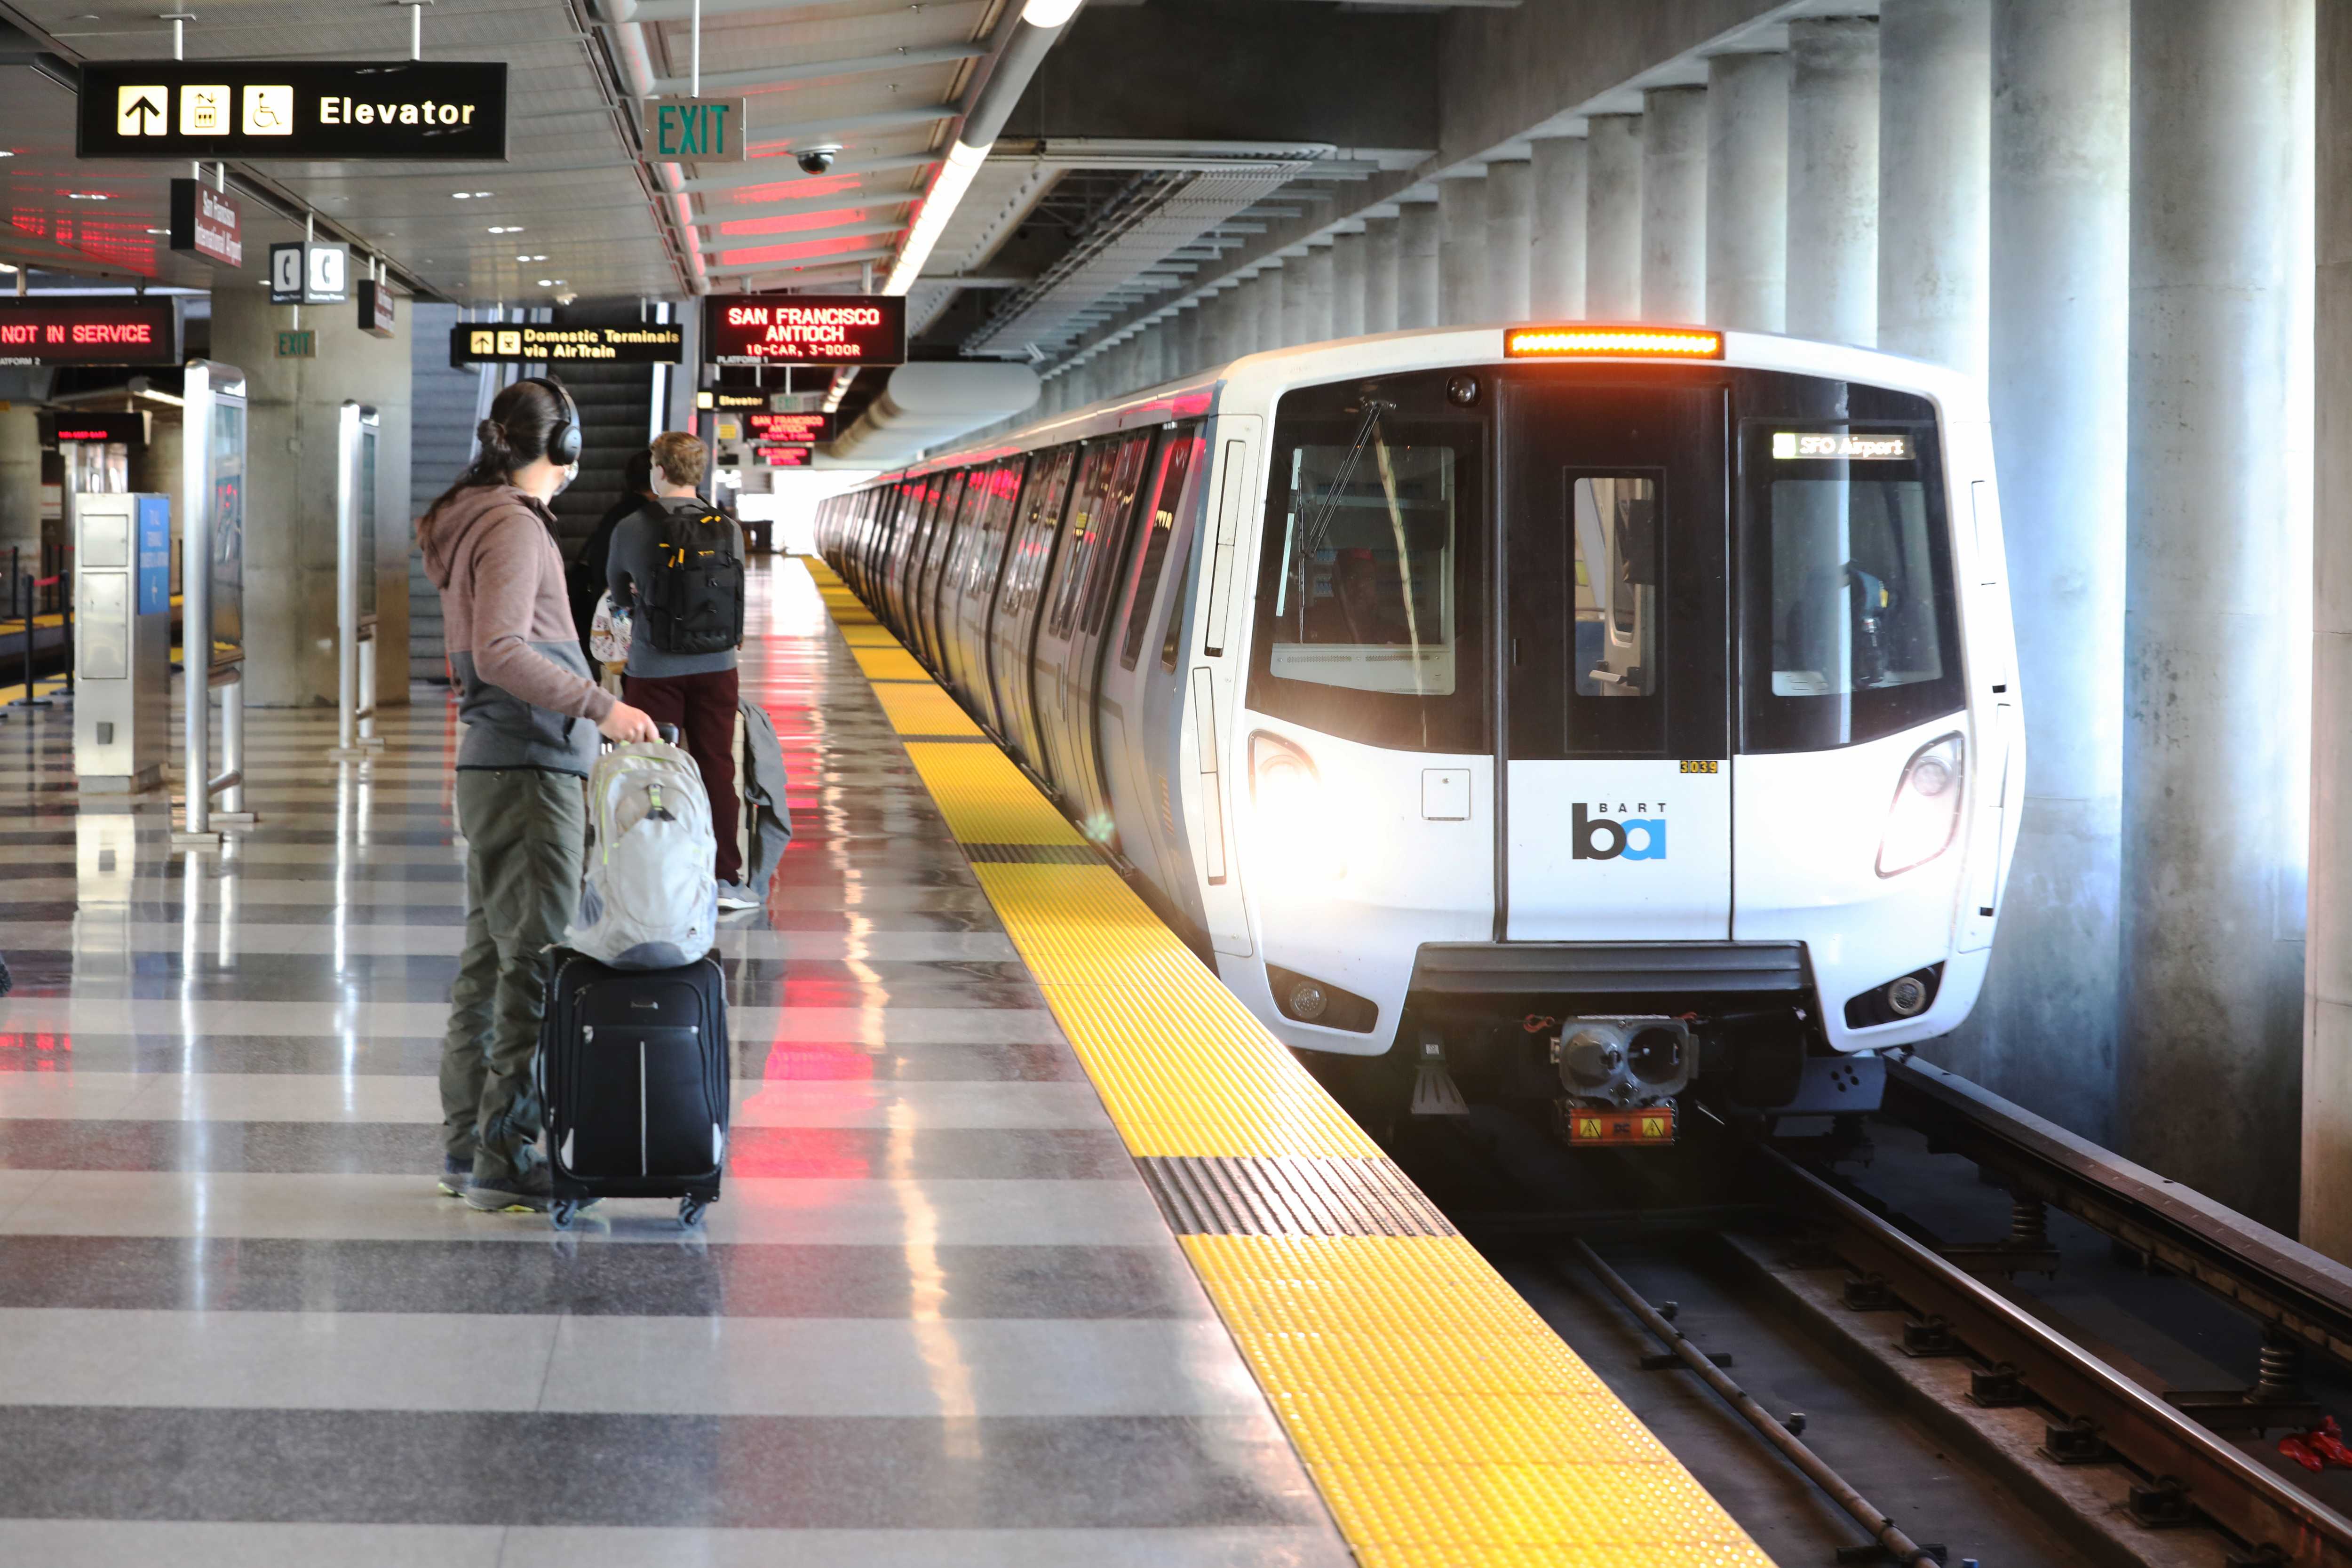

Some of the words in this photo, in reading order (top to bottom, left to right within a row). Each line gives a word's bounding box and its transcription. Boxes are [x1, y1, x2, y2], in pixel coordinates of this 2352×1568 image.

[320, 96, 475, 125] Elevator
[659, 105, 730, 154] EXIT
[728, 308, 768, 325] SAN
[776, 308, 880, 325] FRANCISCO
[1, 325, 39, 343] NOT
[47, 325, 65, 343] IN
[72, 325, 151, 343] SERVICE
[524, 329, 598, 343] Domestic
[605, 330, 680, 343] Terminals
[765, 325, 844, 342] ANTIOCH
[278, 333, 309, 356] EXIT
[524, 346, 548, 358] via
[553, 345, 616, 358] AirTrain
[746, 344, 803, 357] 10-CAR,
[809, 344, 860, 356] 3-DOOR
[719, 396, 763, 406] Elevator
[1800, 437, 1836, 454] SFO
[1837, 437, 1903, 458] Airport
[1680, 761, 1718, 773] 3039
[1599, 803, 1666, 813] BART
